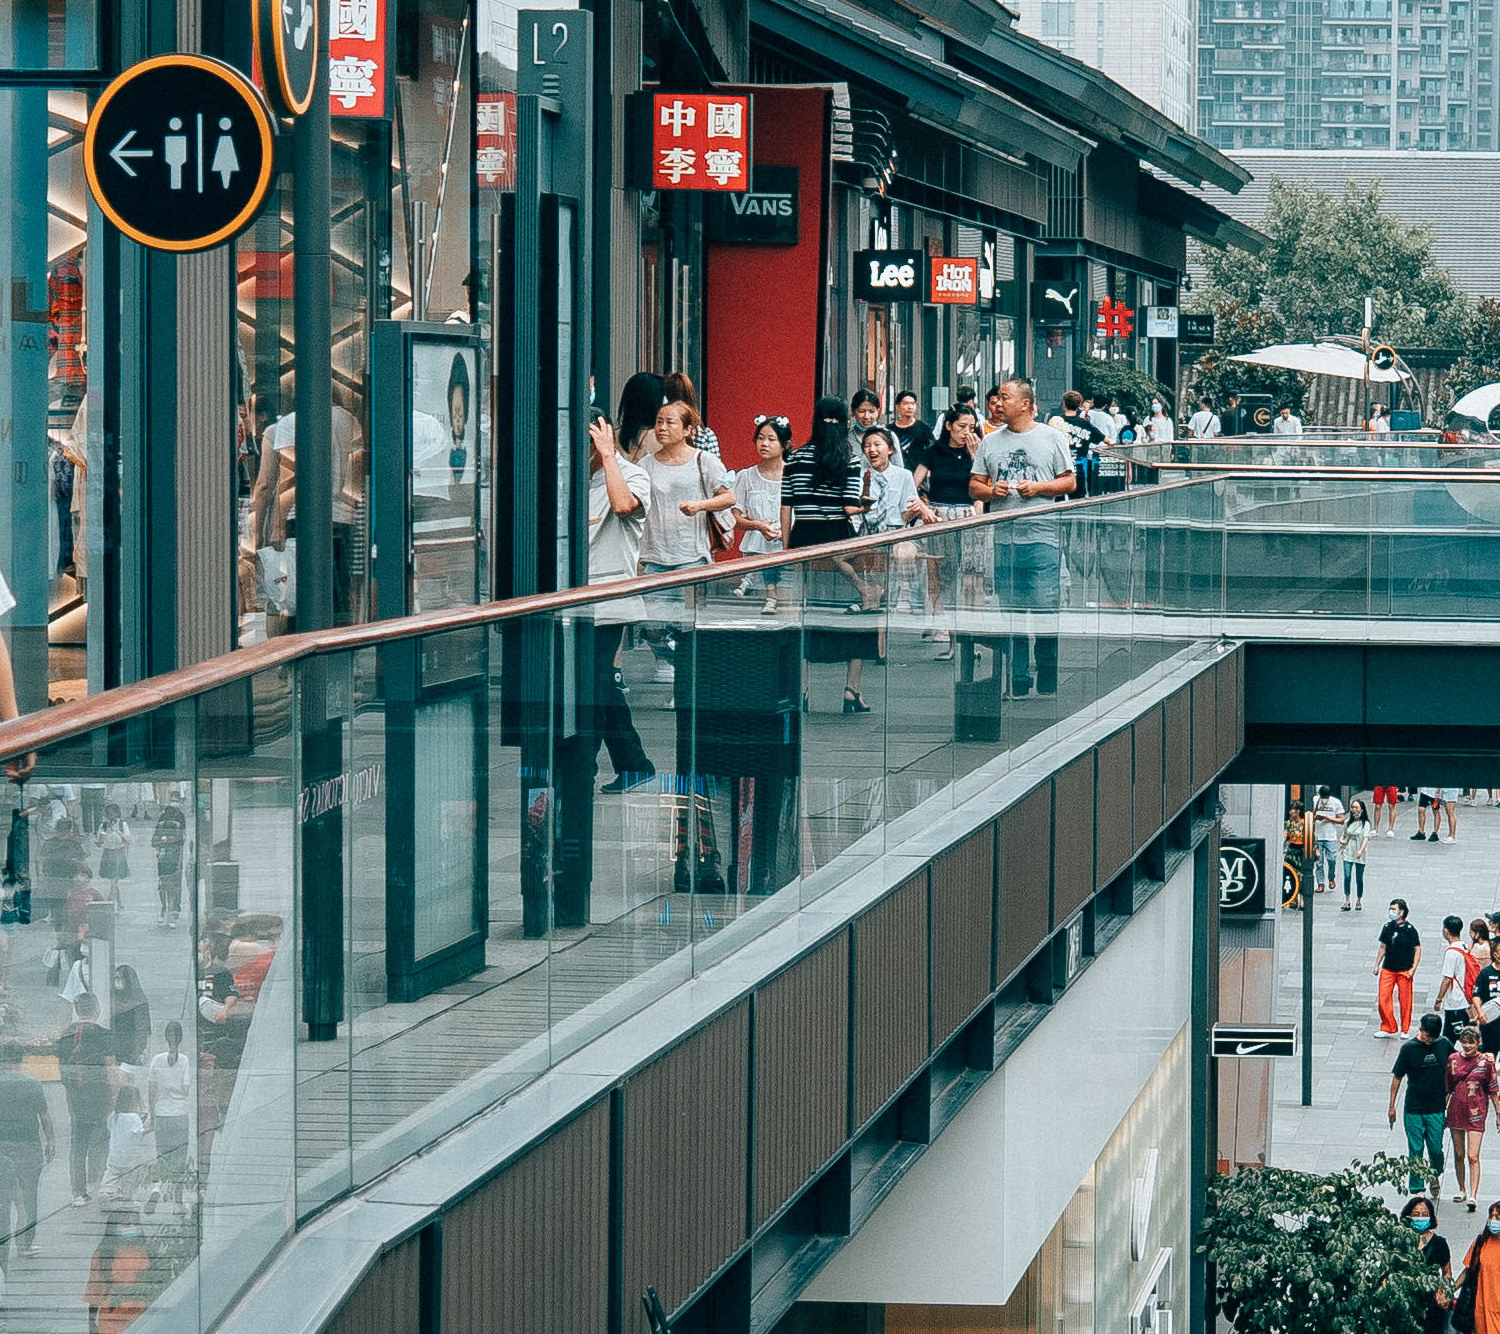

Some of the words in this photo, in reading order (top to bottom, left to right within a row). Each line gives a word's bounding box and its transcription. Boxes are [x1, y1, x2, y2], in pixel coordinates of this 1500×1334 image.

[533, 22, 569, 65] L2
[660, 100, 743, 138] 中國
[658, 147, 744, 186] 李寧
[730, 193, 793, 216] VANS
[870, 259, 915, 288] Lee
